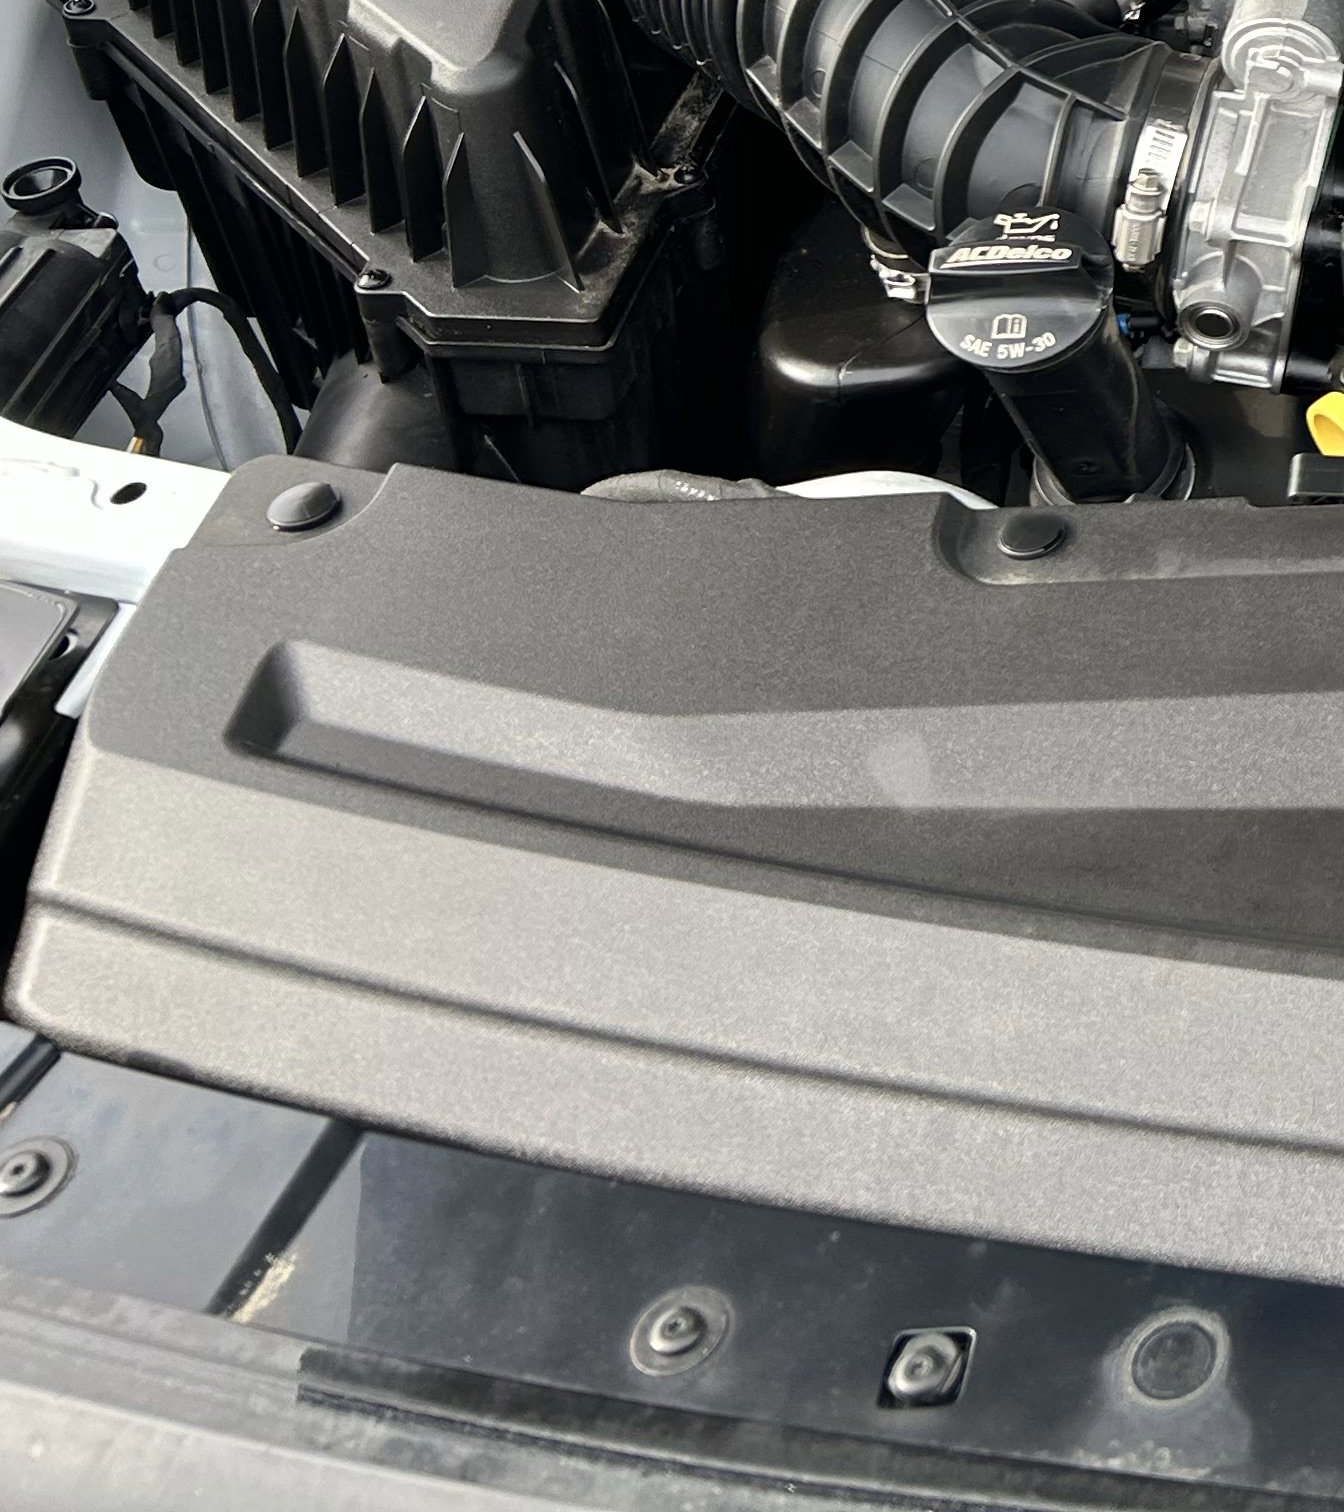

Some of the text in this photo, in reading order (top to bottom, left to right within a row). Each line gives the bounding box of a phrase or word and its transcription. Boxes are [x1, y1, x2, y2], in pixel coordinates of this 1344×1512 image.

[947, 244, 1073, 263] ACDelco
[959, 332, 1057, 360] SAE 5W-30
